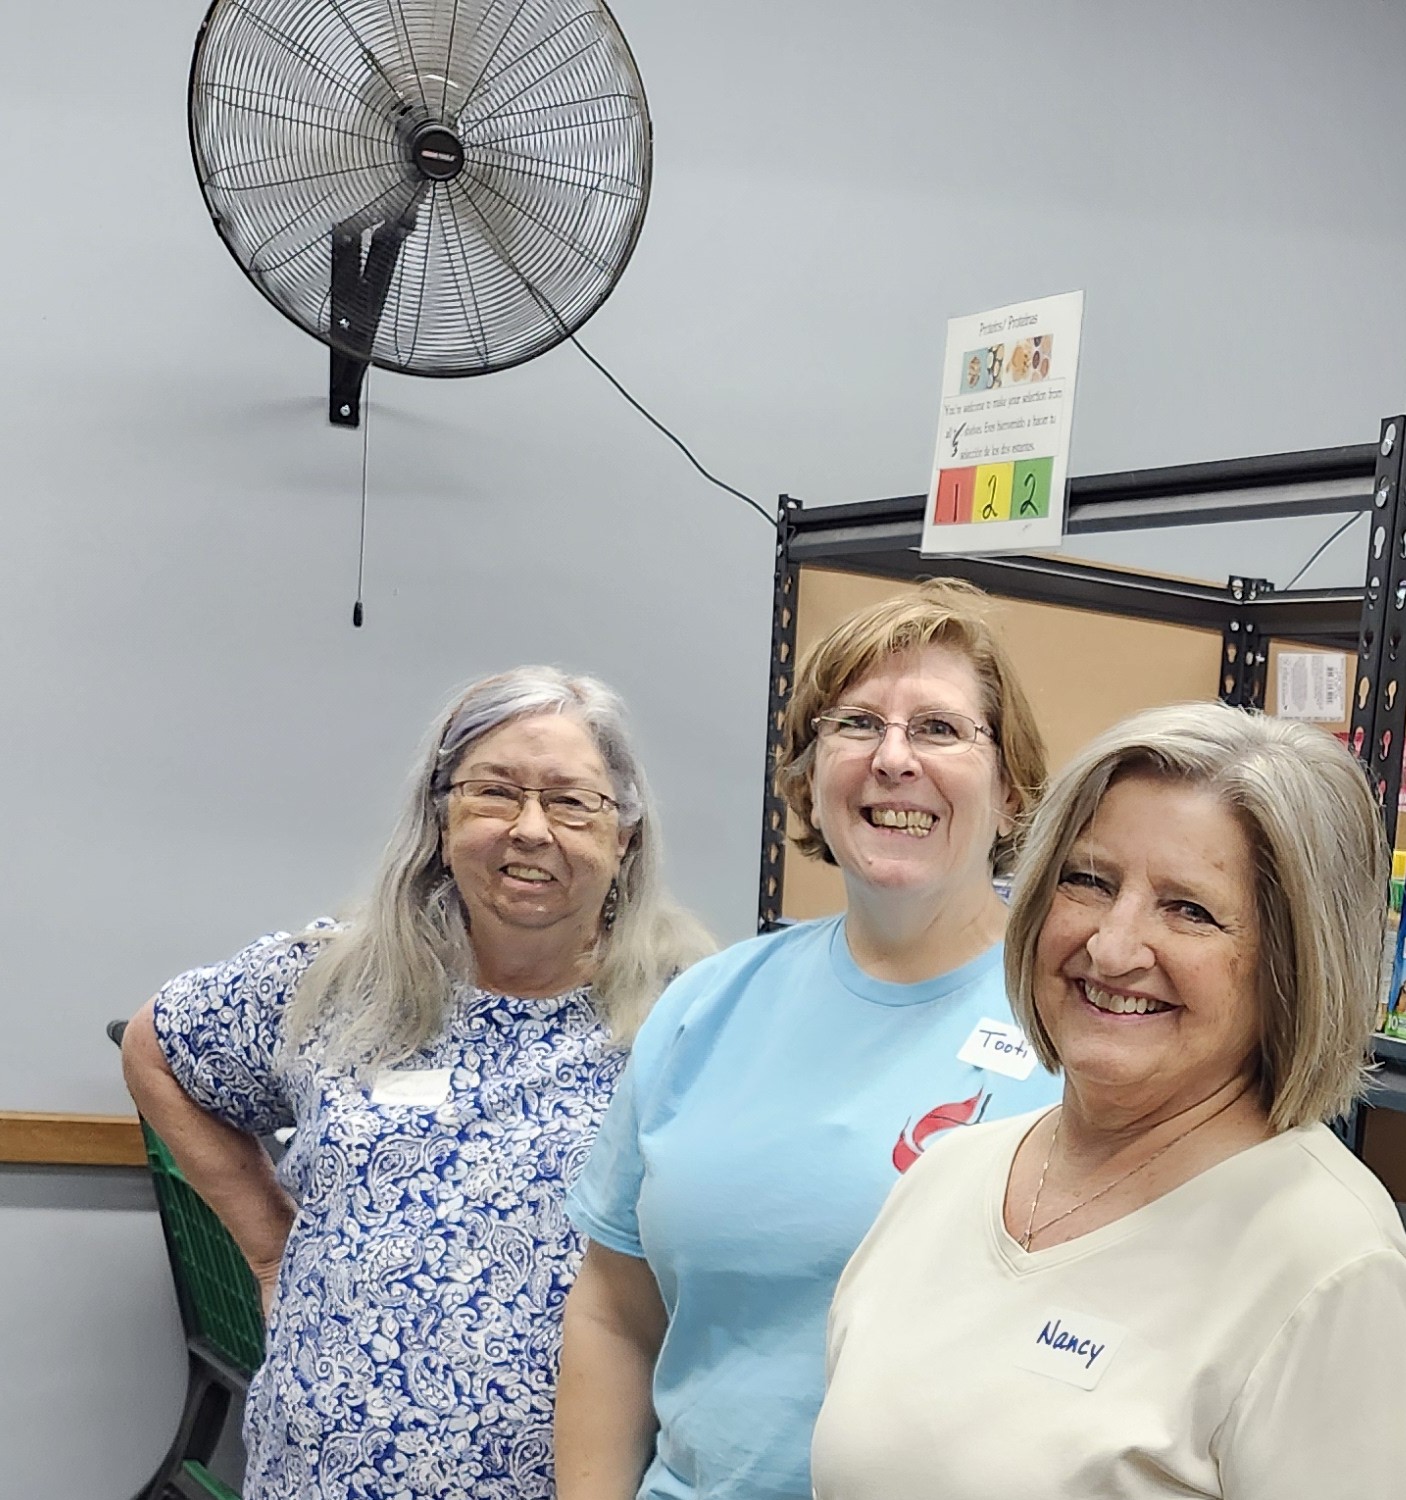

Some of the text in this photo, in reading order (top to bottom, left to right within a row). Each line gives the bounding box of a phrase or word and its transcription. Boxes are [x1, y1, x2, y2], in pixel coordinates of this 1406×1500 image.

[954, 473, 1039, 523] 1 2 2
[1036, 1319, 1105, 1369] Nancy
